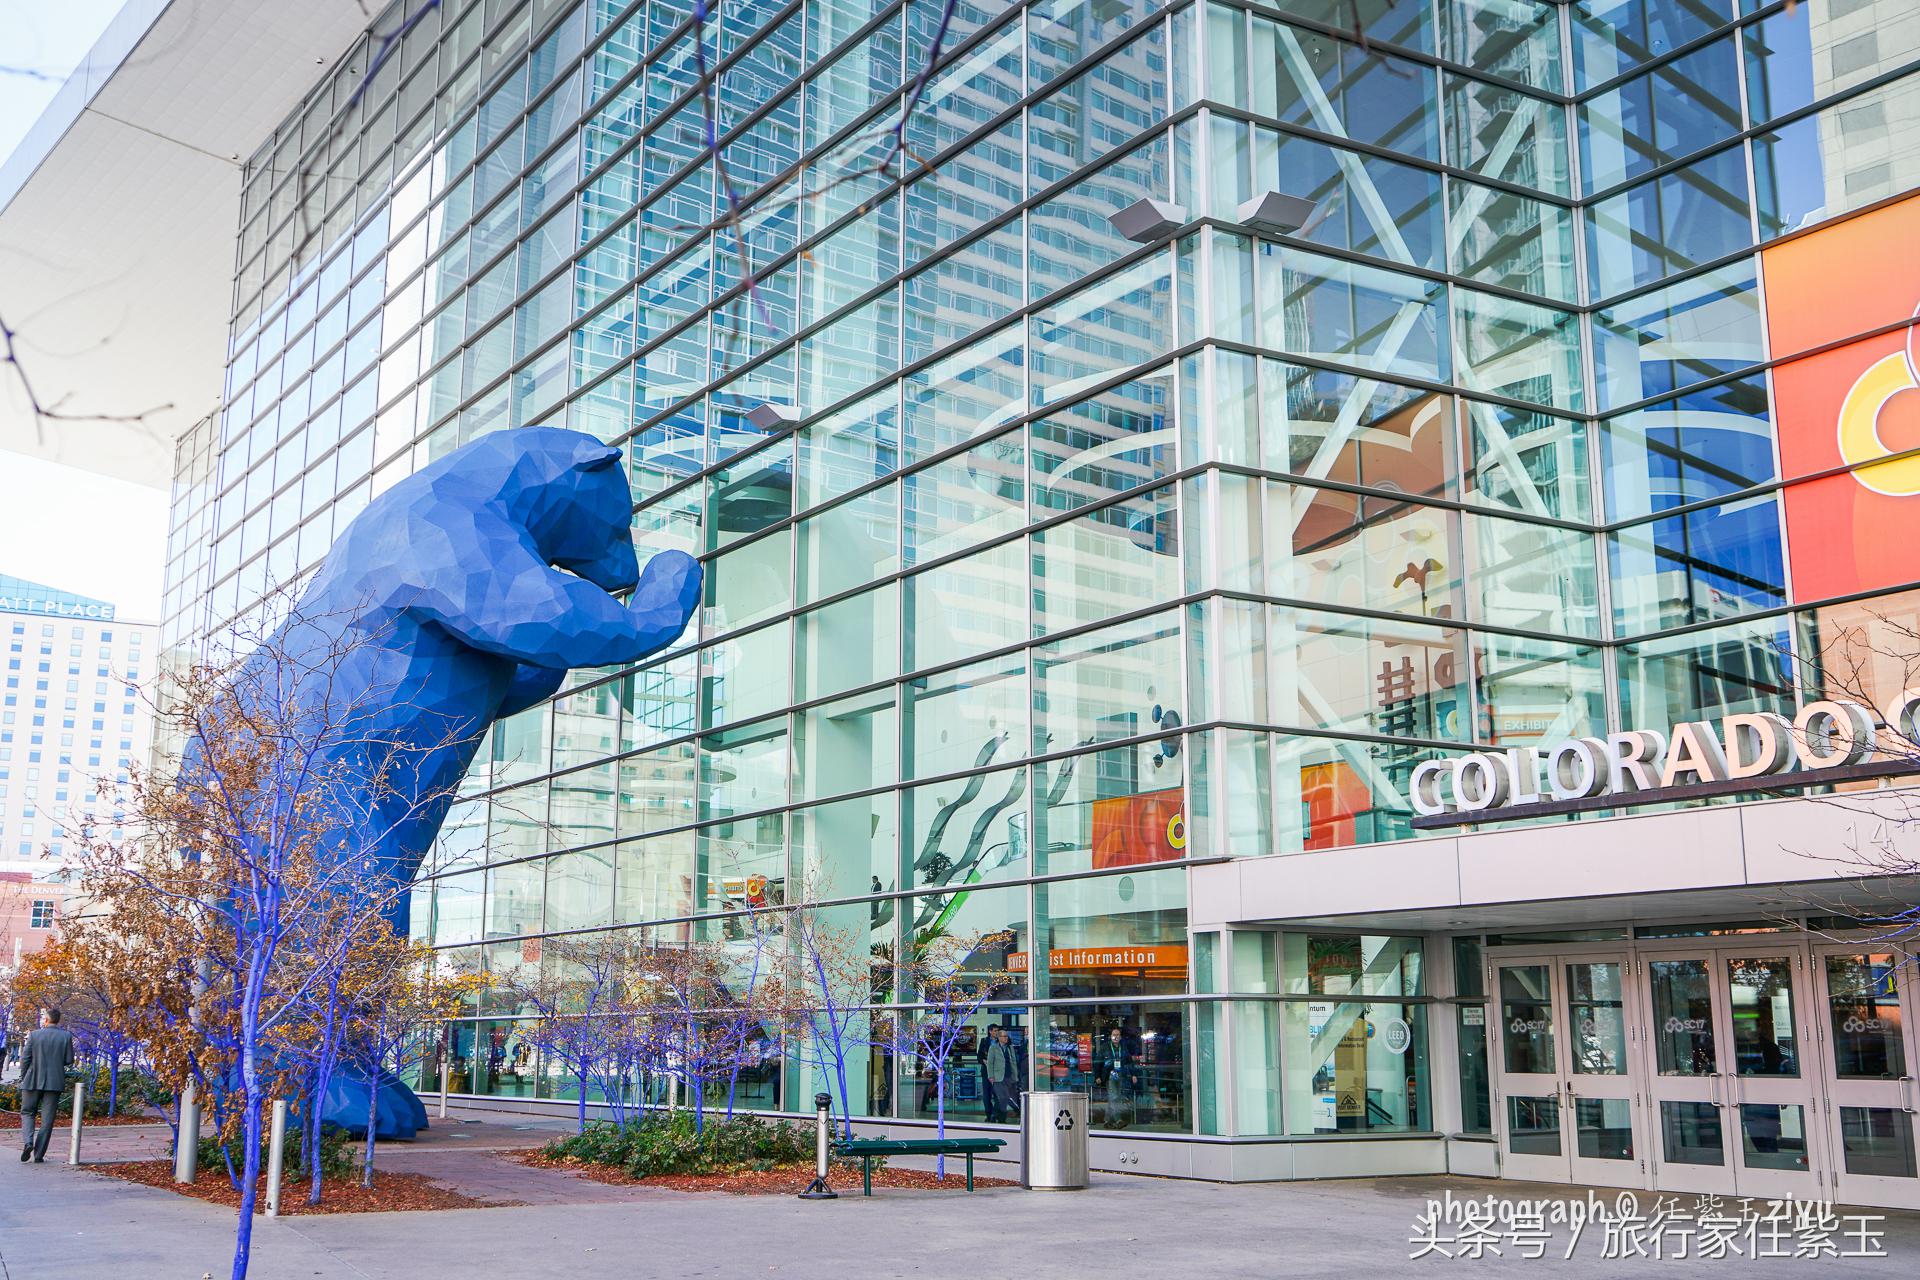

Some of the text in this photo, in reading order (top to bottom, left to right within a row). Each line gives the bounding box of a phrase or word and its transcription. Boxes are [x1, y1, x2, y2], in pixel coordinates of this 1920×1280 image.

[45, 600, 113, 618] PLACE
[1410, 700, 1858, 815] COLORADO
[1069, 949, 1156, 965] Information
[1527, 1020, 1545, 1030] SC17
[1683, 1019, 1705, 1029] SC17
[1388, 1030, 1405, 1040] LEED
